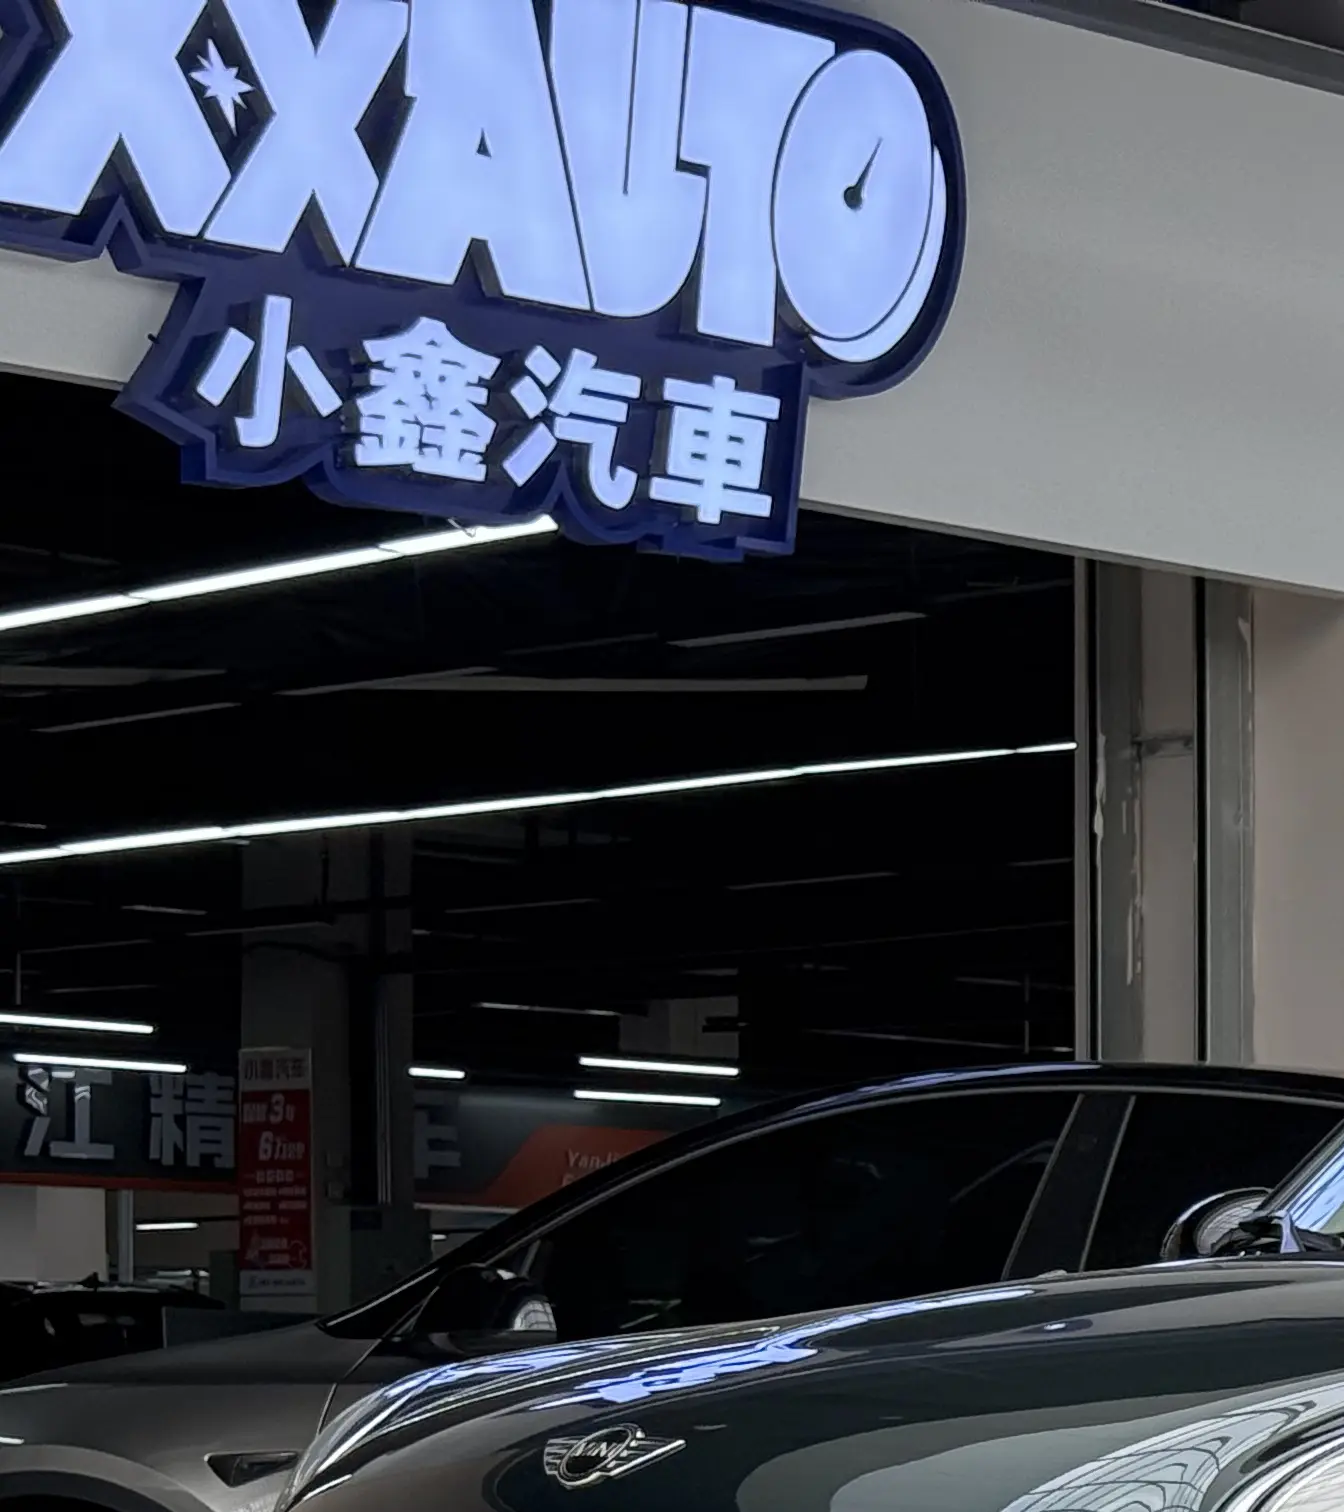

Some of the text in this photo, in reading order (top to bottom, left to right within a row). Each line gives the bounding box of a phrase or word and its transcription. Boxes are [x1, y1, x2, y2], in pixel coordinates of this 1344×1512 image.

[0, 0, 948, 362] XXAUTO
[197, 295, 782, 525] 小鑫汽車
